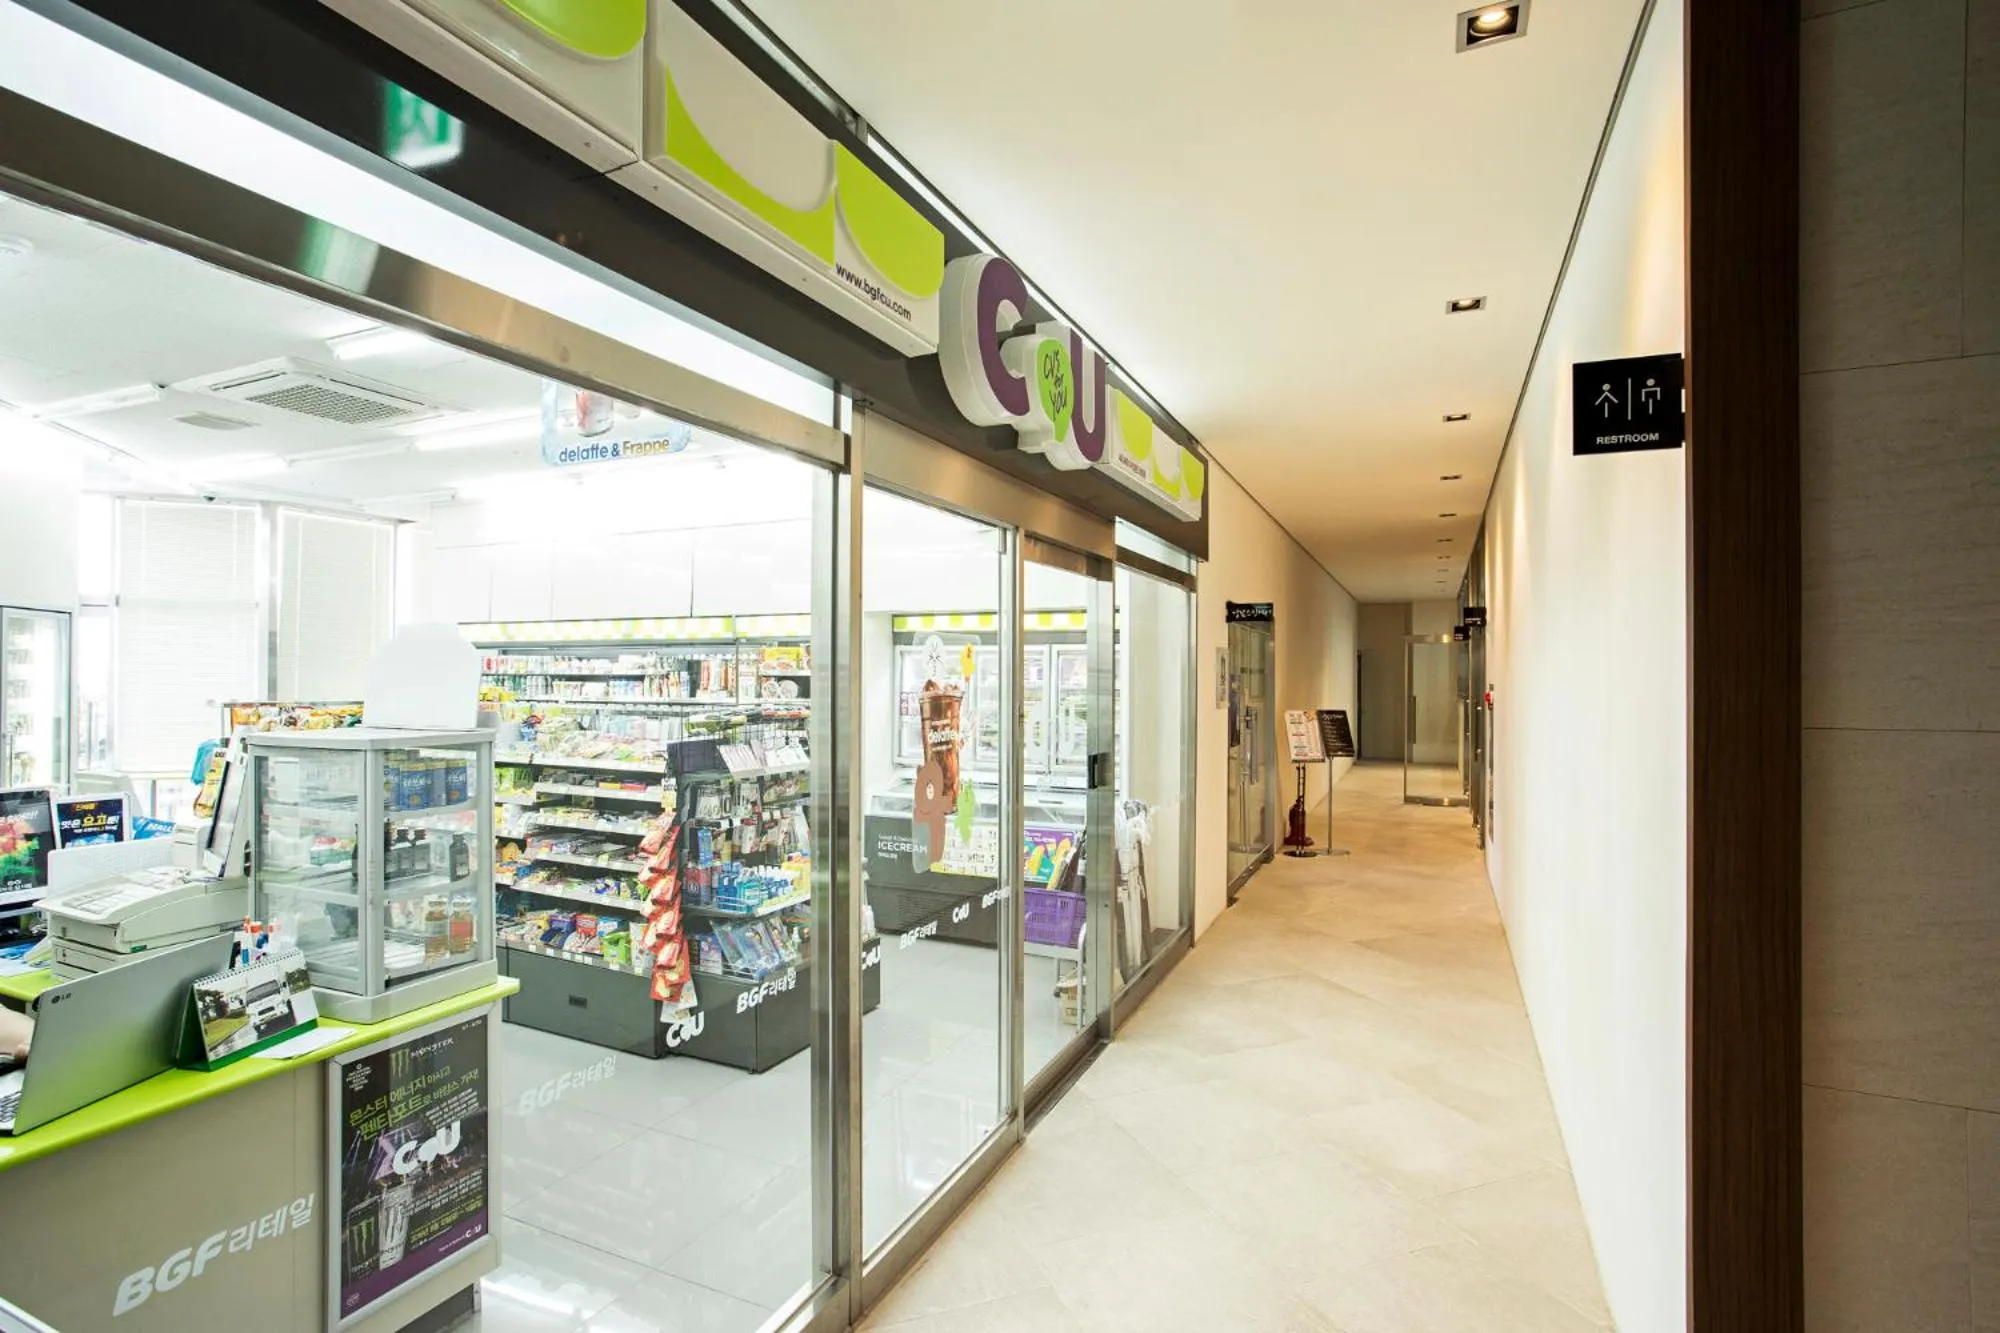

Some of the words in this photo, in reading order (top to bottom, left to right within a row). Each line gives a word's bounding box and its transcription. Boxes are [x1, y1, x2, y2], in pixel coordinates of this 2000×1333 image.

[835, 261, 912, 322] www.bgfcu.com
[977, 257, 1107, 463] CU
[1043, 349, 1061, 381] CVS
[623, 438, 670, 458] Frappe
[1596, 433, 1660, 445] RESTROOM
[878, 840, 928, 855] ICECREAM
[736, 967, 797, 1014] BGF리테일
[390, 1072, 426, 1102] 에너지
[518, 1055, 616, 1117] BGF리테일
[113, 1193, 315, 1317] BGF리테일
